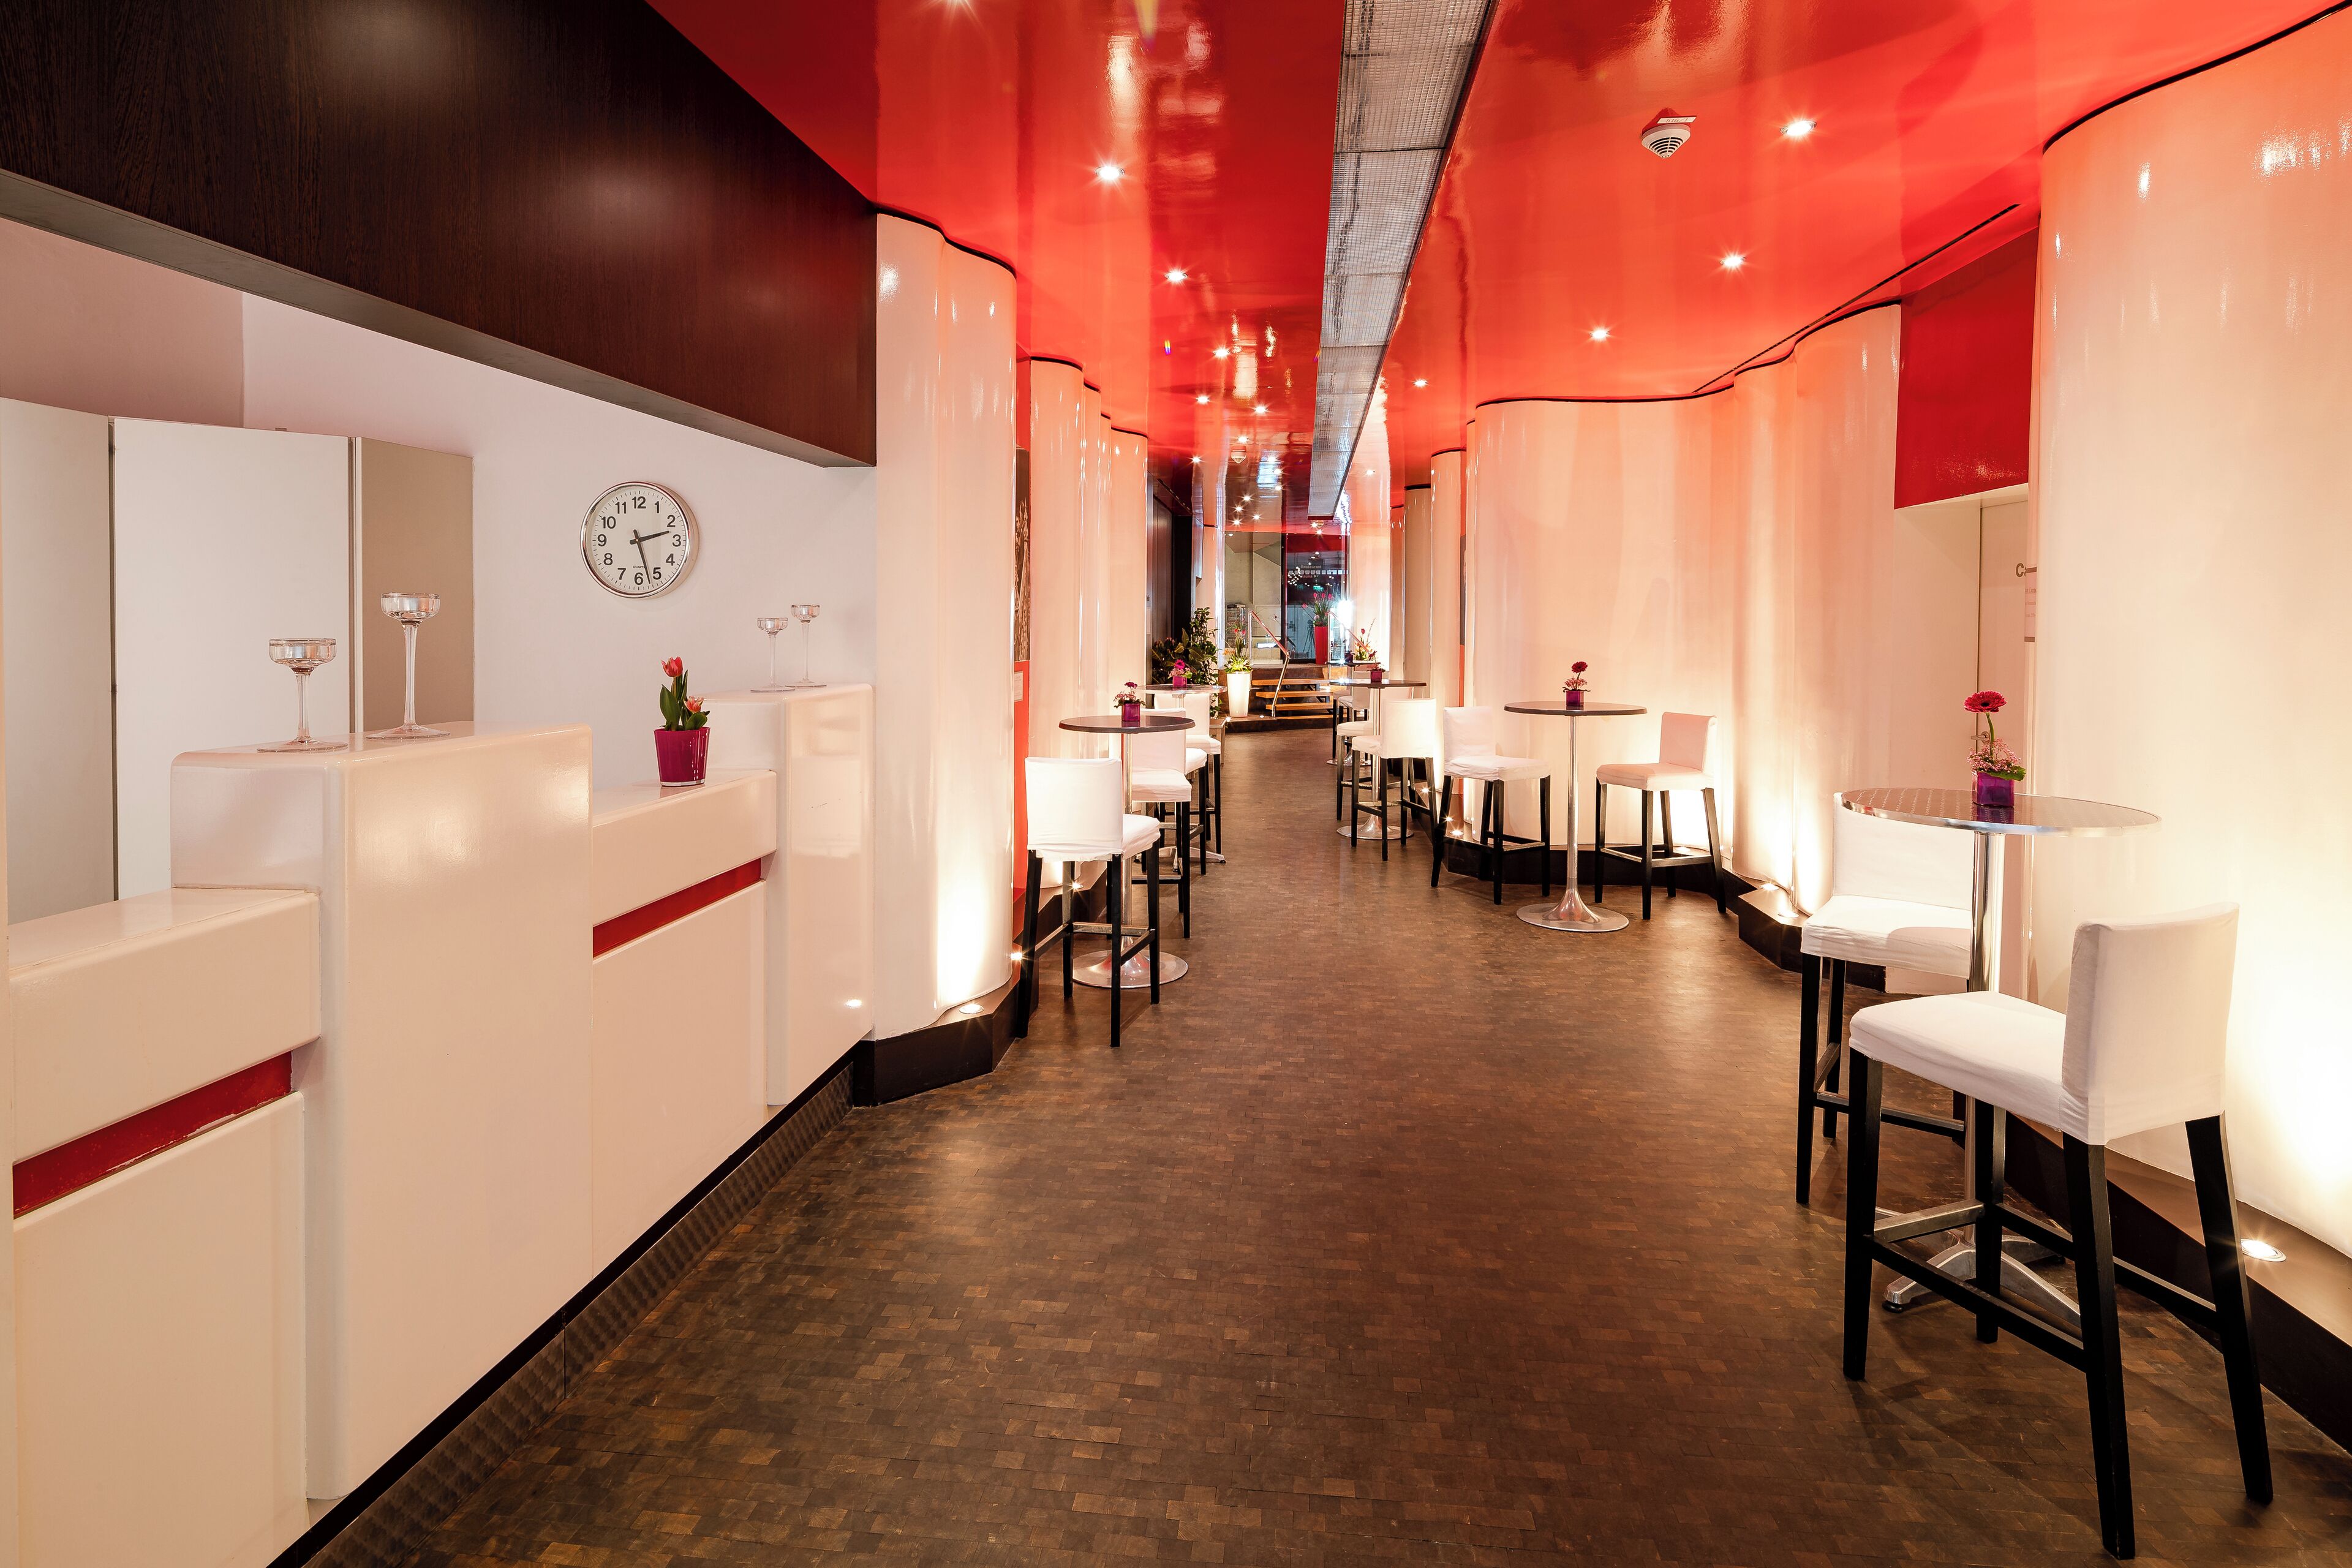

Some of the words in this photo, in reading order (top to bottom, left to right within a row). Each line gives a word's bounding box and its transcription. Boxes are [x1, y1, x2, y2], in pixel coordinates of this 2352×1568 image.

[616, 502, 627, 514] 11
[632, 496, 646, 508] 12
[655, 501, 660, 513] 1
[601, 516, 616, 529] 10
[667, 514, 676, 527] 2
[597, 534, 607, 546] 9
[672, 534, 681, 547] 3
[603, 553, 613, 565] 8
[666, 554, 675, 566] 4
[617, 568, 626, 580] 7
[652, 567, 662, 579] 5
[2016, 563, 2026, 577] C
[634, 573, 643, 585] 6
